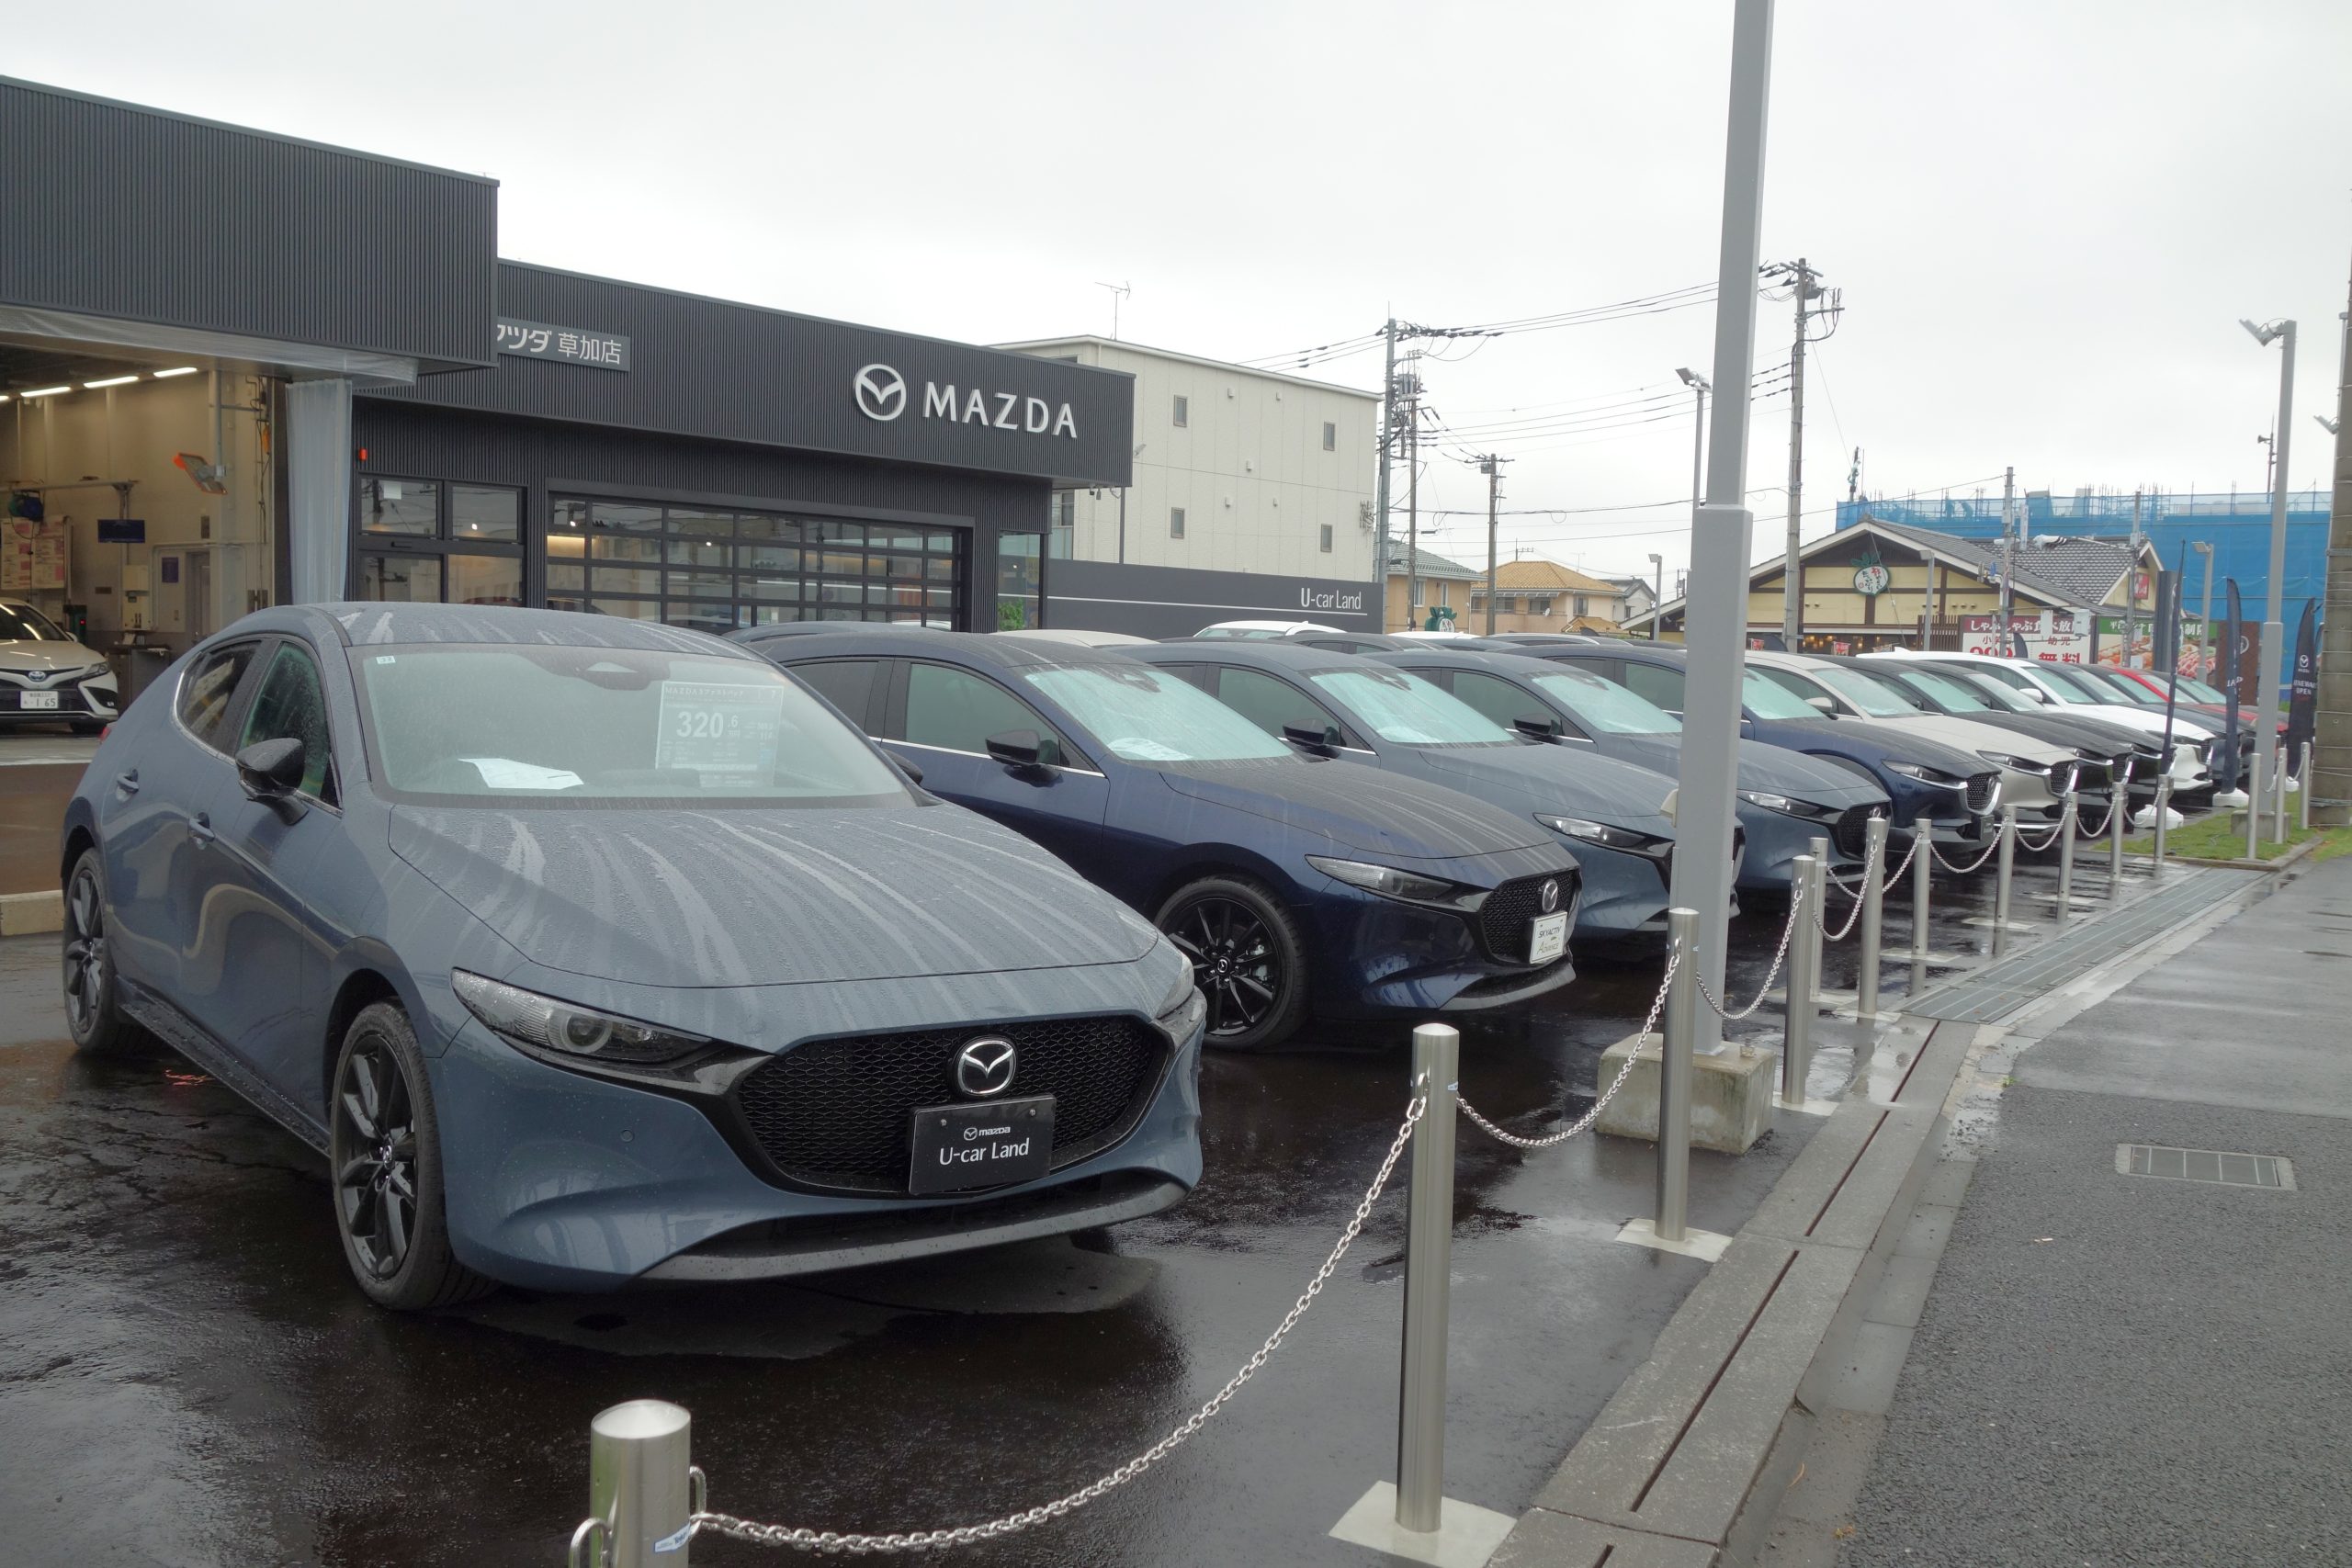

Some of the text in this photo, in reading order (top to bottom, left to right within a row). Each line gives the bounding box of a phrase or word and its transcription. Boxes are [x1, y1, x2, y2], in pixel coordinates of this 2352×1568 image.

[558, 332, 622, 365] 草加店
[922, 381, 1078, 438] MAZDA
[1301, 588, 1362, 610] U-car Land
[939, 1137, 1030, 1166] U-car Land
